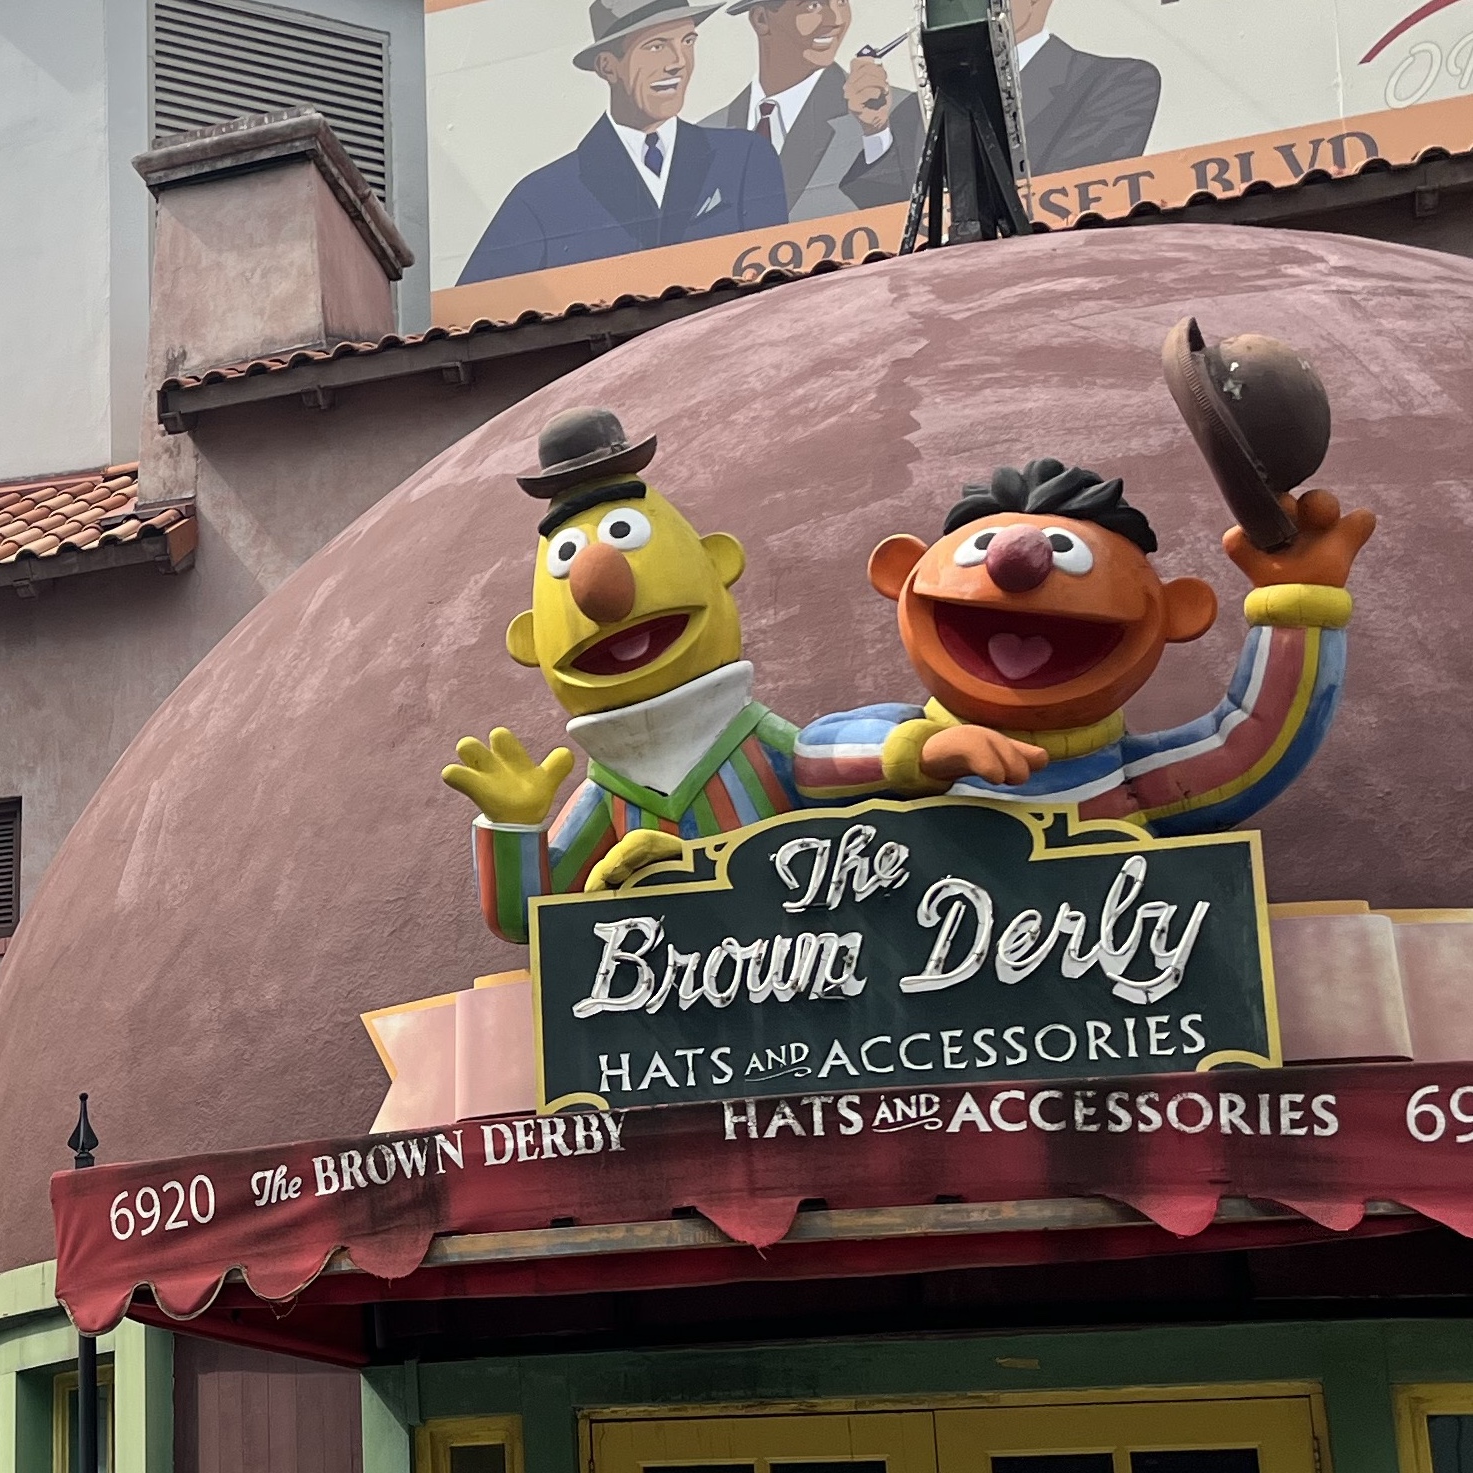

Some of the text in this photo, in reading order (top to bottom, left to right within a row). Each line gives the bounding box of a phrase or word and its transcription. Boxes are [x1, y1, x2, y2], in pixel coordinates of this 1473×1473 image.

[732, 226, 880, 281] 6920
[769, 824, 911, 913] The
[572, 855, 1211, 1019] Brown Derby
[598, 1013, 1207, 1093] HATS AND ACCESSORIES
[109, 1173, 217, 1242] 6920
[250, 1164, 302, 1208] The
[312, 1128, 466, 1198] BROWN
[480, 1109, 628, 1168] DERBY
[722, 1094, 865, 1141] HATS
[871, 1093, 944, 1134] AND
[945, 1090, 1340, 1137] ACCESSORIES
